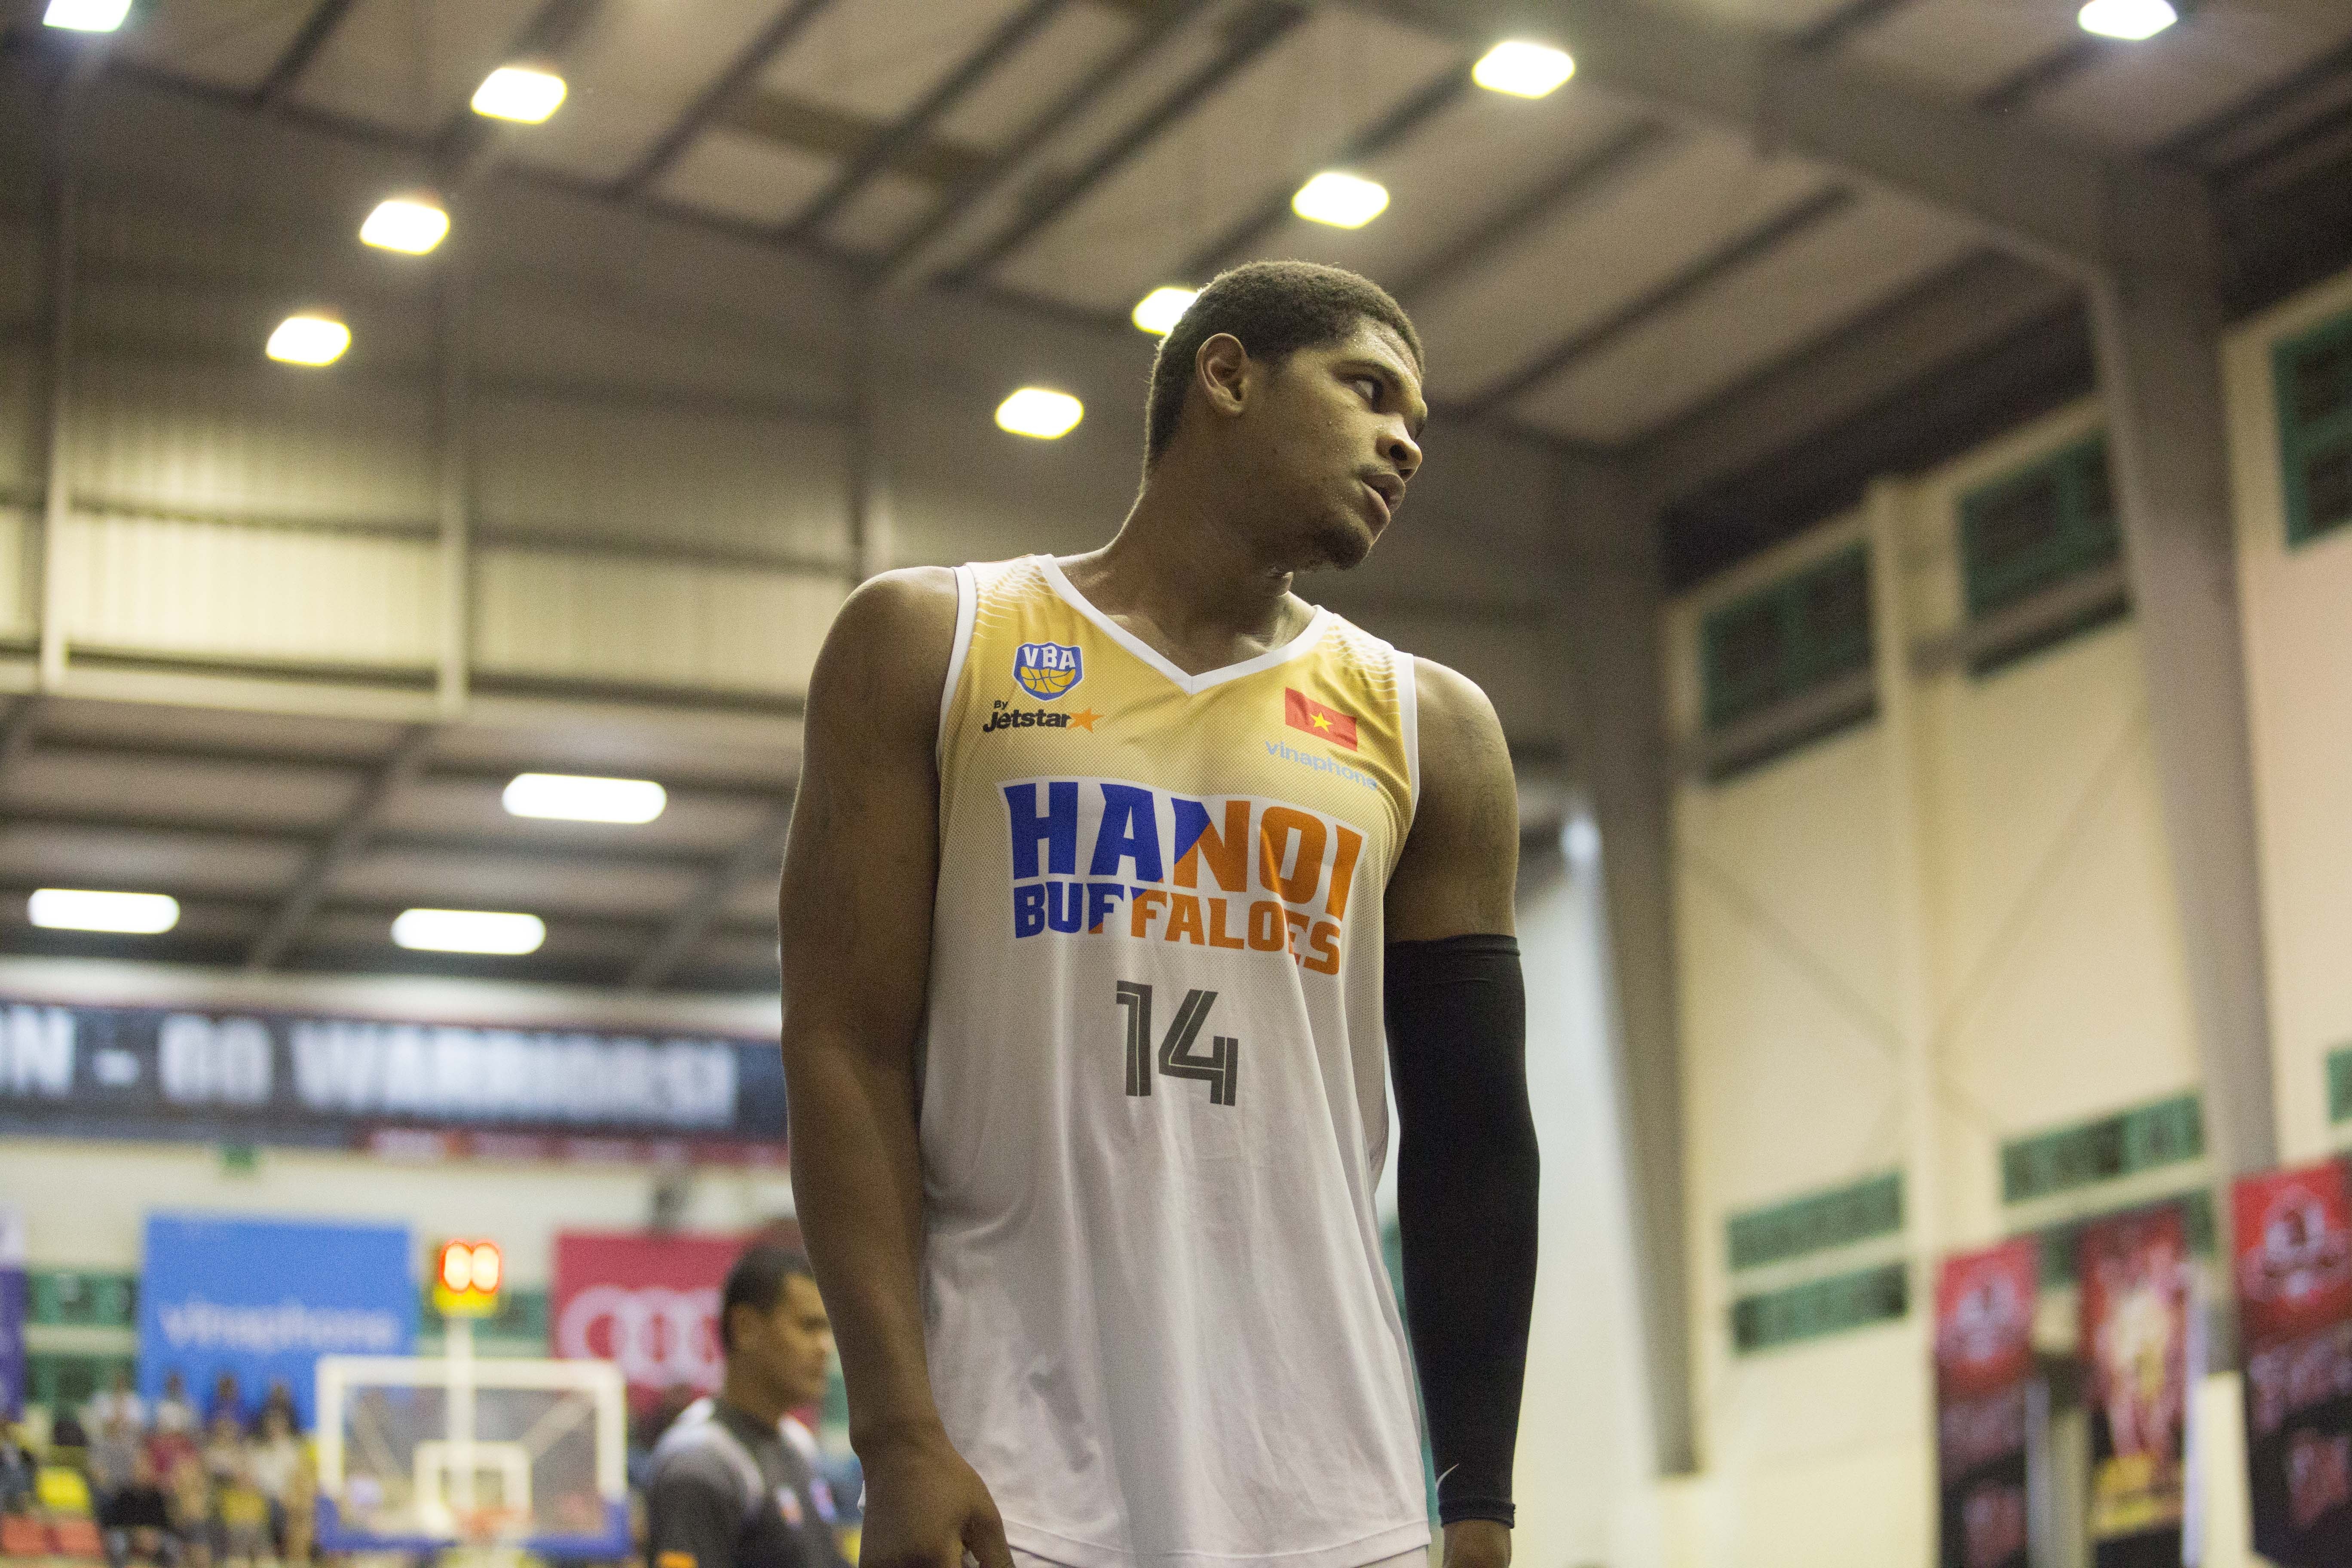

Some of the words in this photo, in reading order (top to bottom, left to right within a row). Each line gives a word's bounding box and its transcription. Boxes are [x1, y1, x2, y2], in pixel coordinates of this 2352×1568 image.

[1022, 646, 1076, 669] VBA
[983, 709, 1072, 732] Jetstar
[994, 700, 1008, 710] By
[1265, 740, 1378, 791] vinaphone
[1004, 781, 1363, 921] HANOI
[1014, 881, 1341, 975] BUFFALOES
[1117, 980, 1238, 1106] 14
